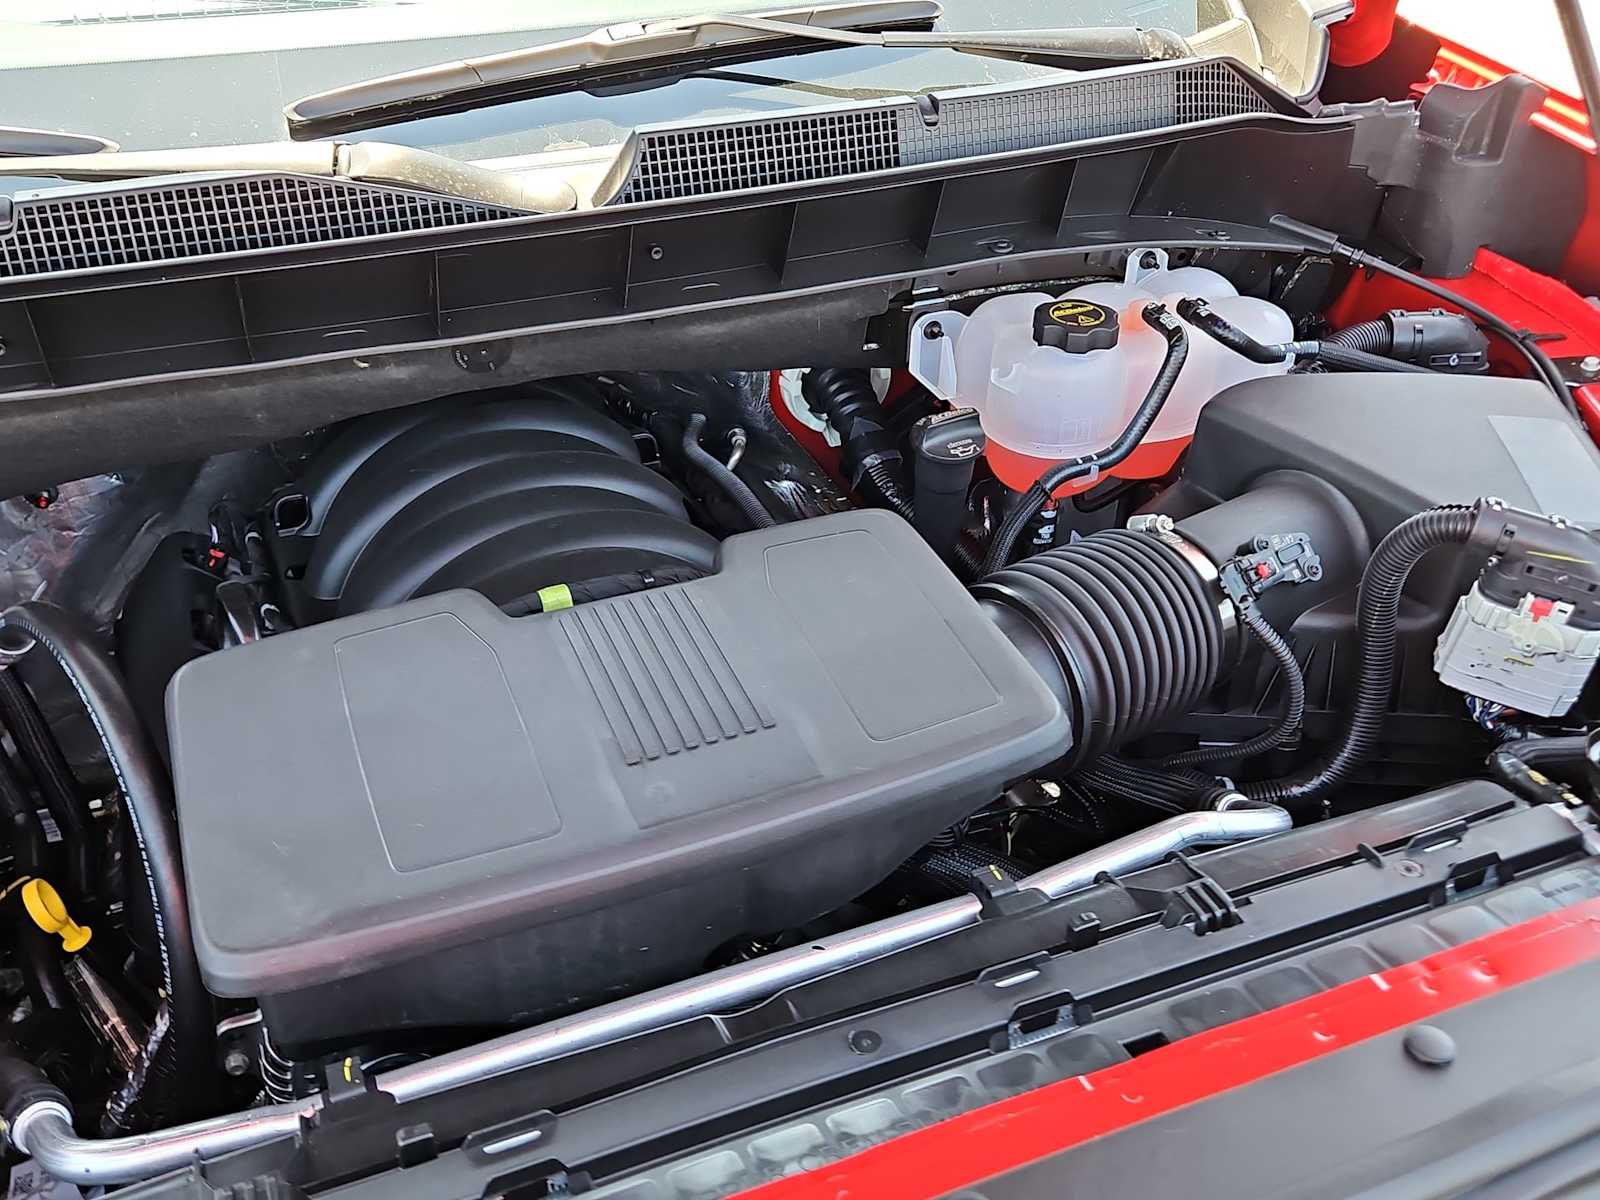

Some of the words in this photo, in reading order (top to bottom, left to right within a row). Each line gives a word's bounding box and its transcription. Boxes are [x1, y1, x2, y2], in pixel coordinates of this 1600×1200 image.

[1053, 306, 1094, 317] ACDelco
[929, 408, 974, 424] ACDelco
[160, 940, 173, 995] GALAXY
